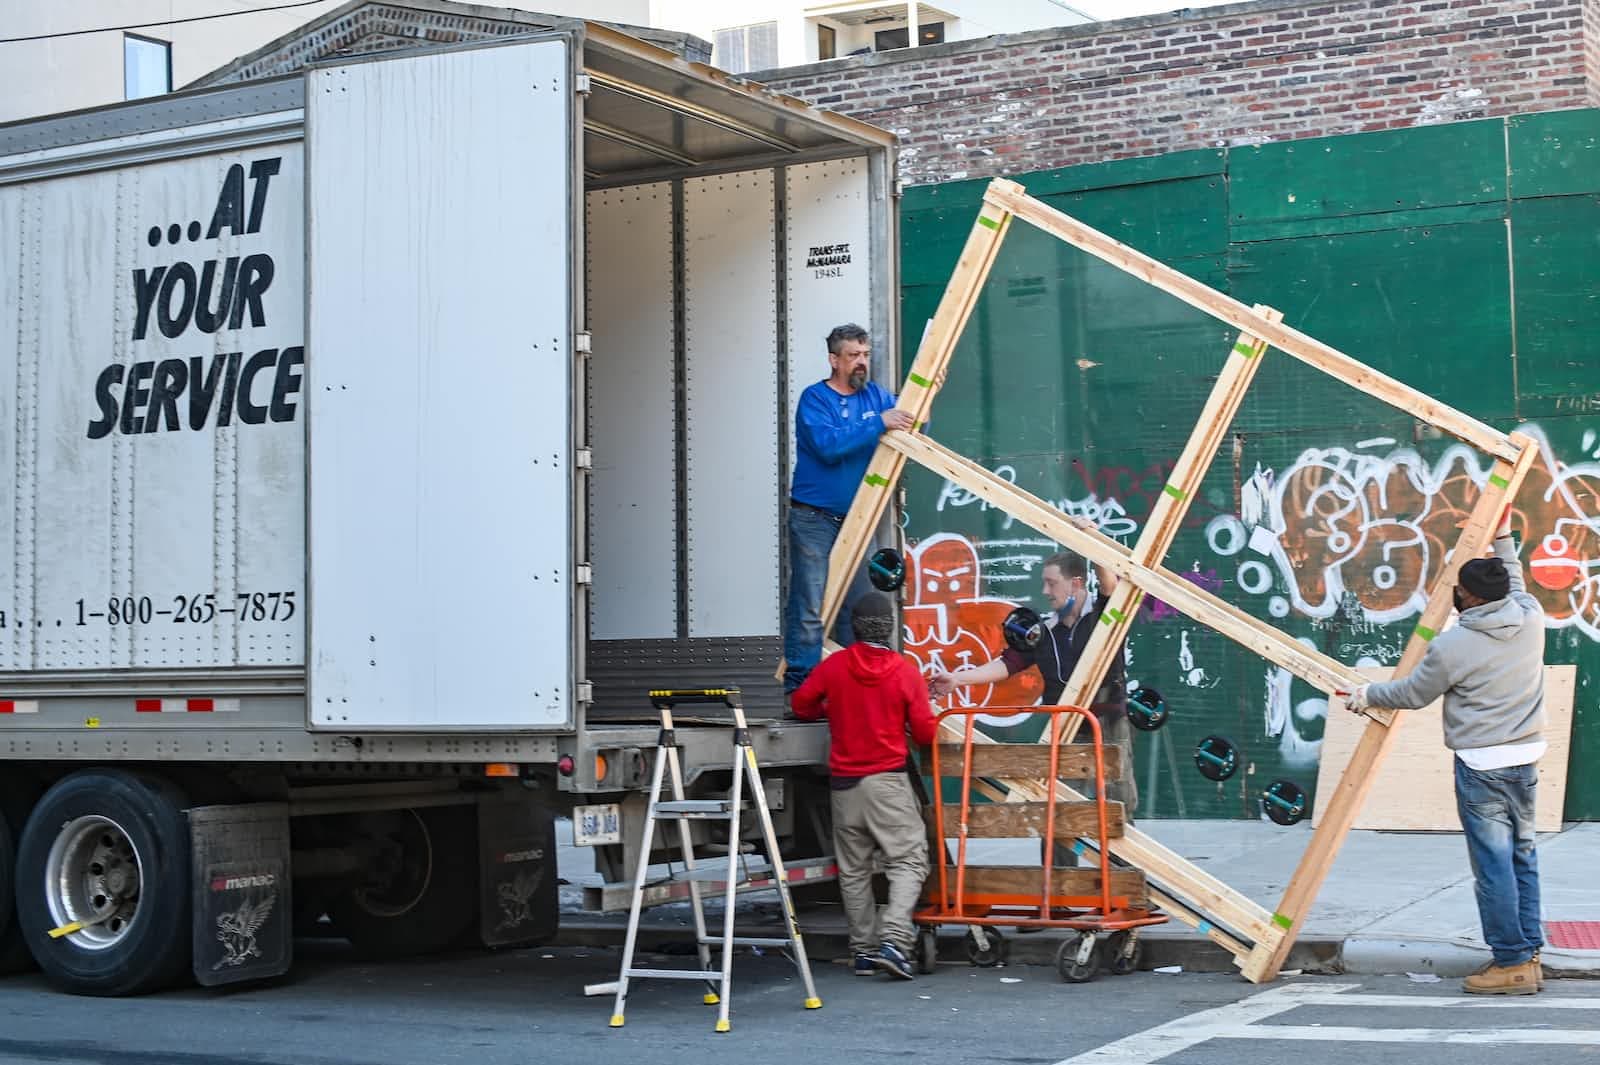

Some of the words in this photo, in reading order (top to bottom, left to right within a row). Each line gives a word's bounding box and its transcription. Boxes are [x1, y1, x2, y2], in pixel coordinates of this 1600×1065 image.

[132, 253, 275, 341] YOUR
[86, 345, 304, 440] SERVICE
[75, 591, 296, 626] 1-800-265-7875
[504, 849, 544, 863] manac
[225, 874, 275, 890] manac
